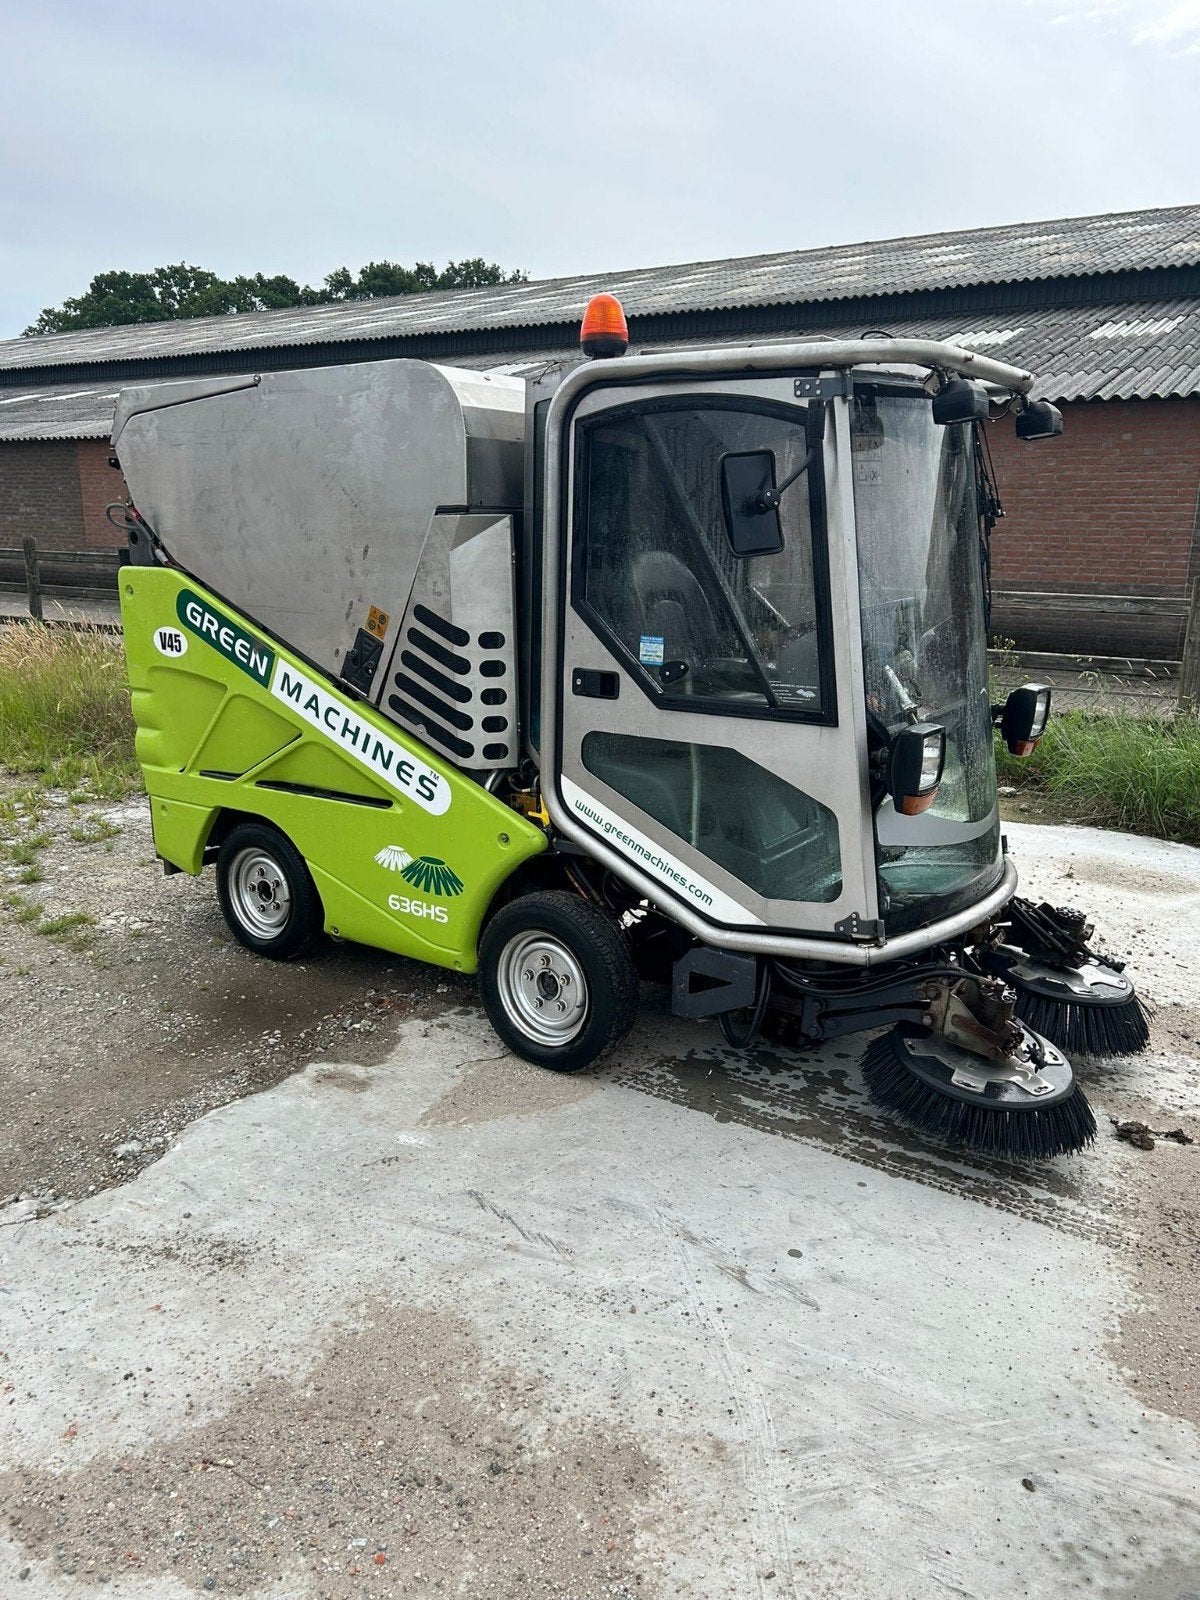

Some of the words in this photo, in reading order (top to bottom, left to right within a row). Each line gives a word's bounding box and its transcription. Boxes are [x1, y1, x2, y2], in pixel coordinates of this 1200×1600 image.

[159, 631, 182, 653] V45
[186, 602, 268, 677] GREEN
[280, 672, 438, 802] MACHINES
[574, 799, 713, 906] www.greenmachines.com
[388, 894, 449, 924] 636HS
